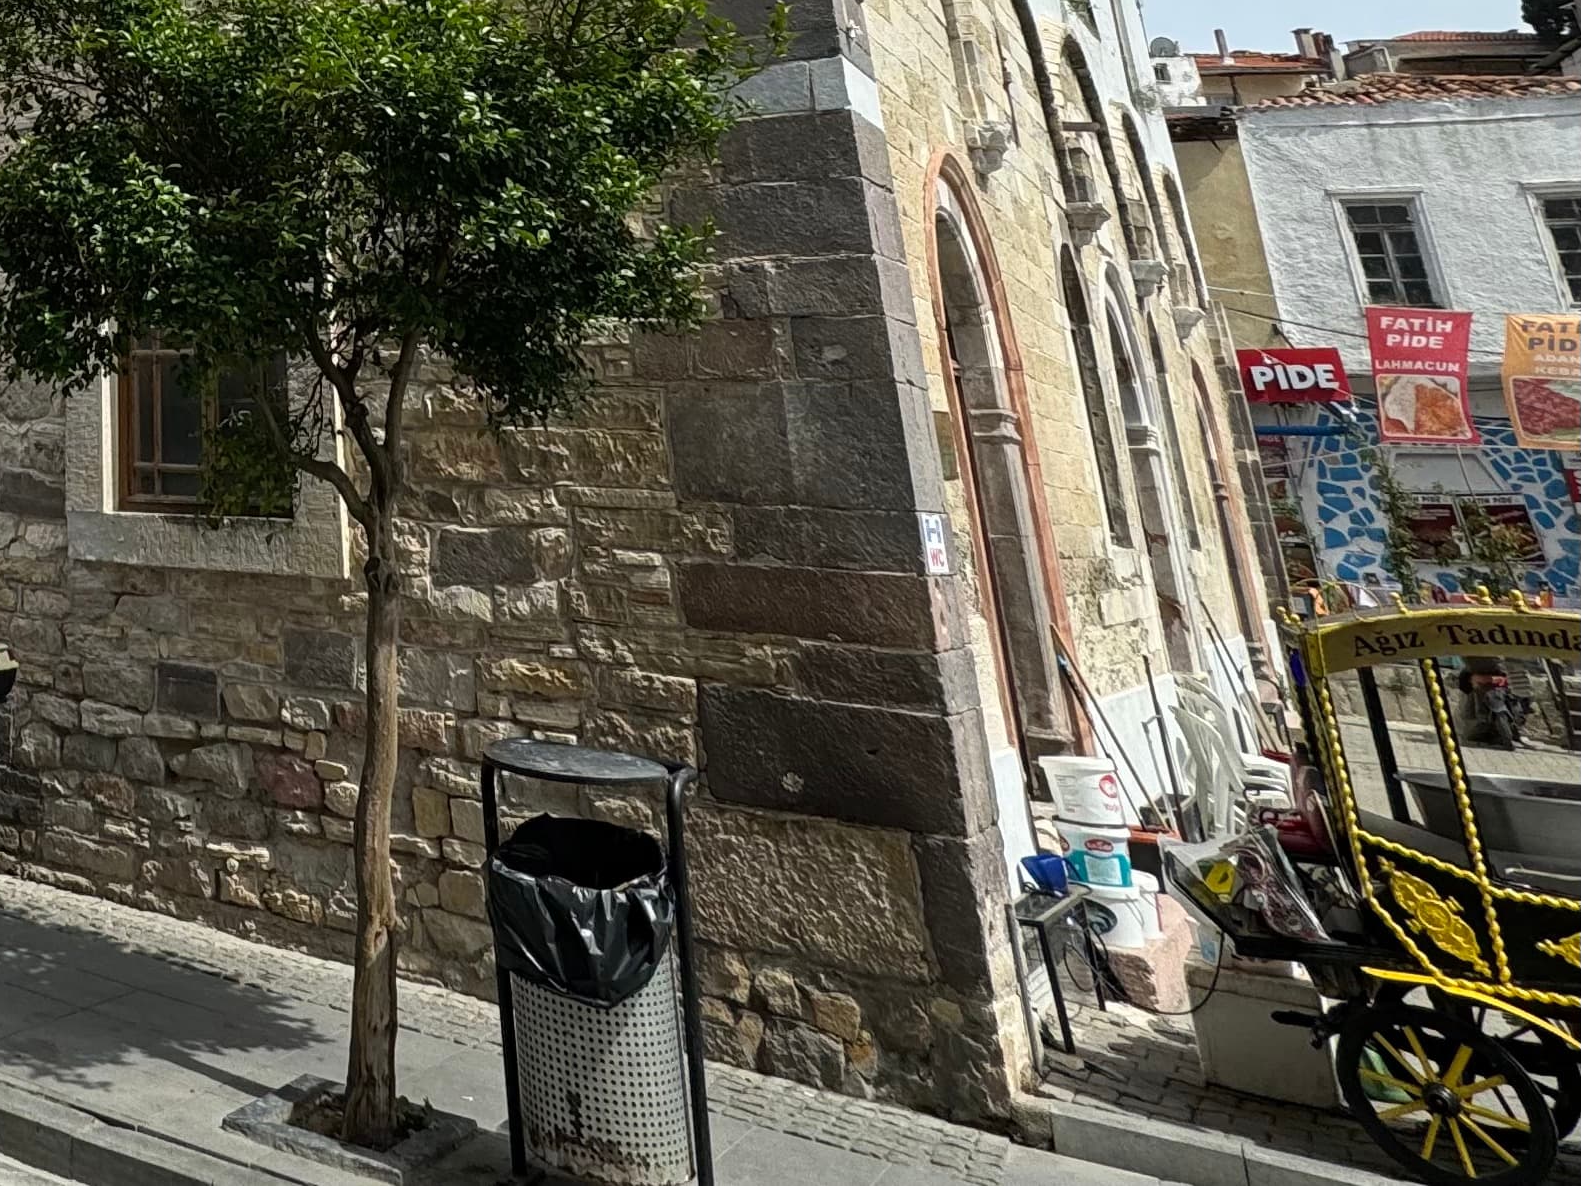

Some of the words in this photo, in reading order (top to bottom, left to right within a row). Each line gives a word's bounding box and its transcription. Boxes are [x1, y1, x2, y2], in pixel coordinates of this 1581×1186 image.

[1380, 316, 1453, 333] FATİH
[1386, 333, 1445, 349] PİDE
[1374, 359, 1461, 372] LAHMACUN
[930, 548, 945, 567] WC
[1353, 630, 1425, 657] Ağız
